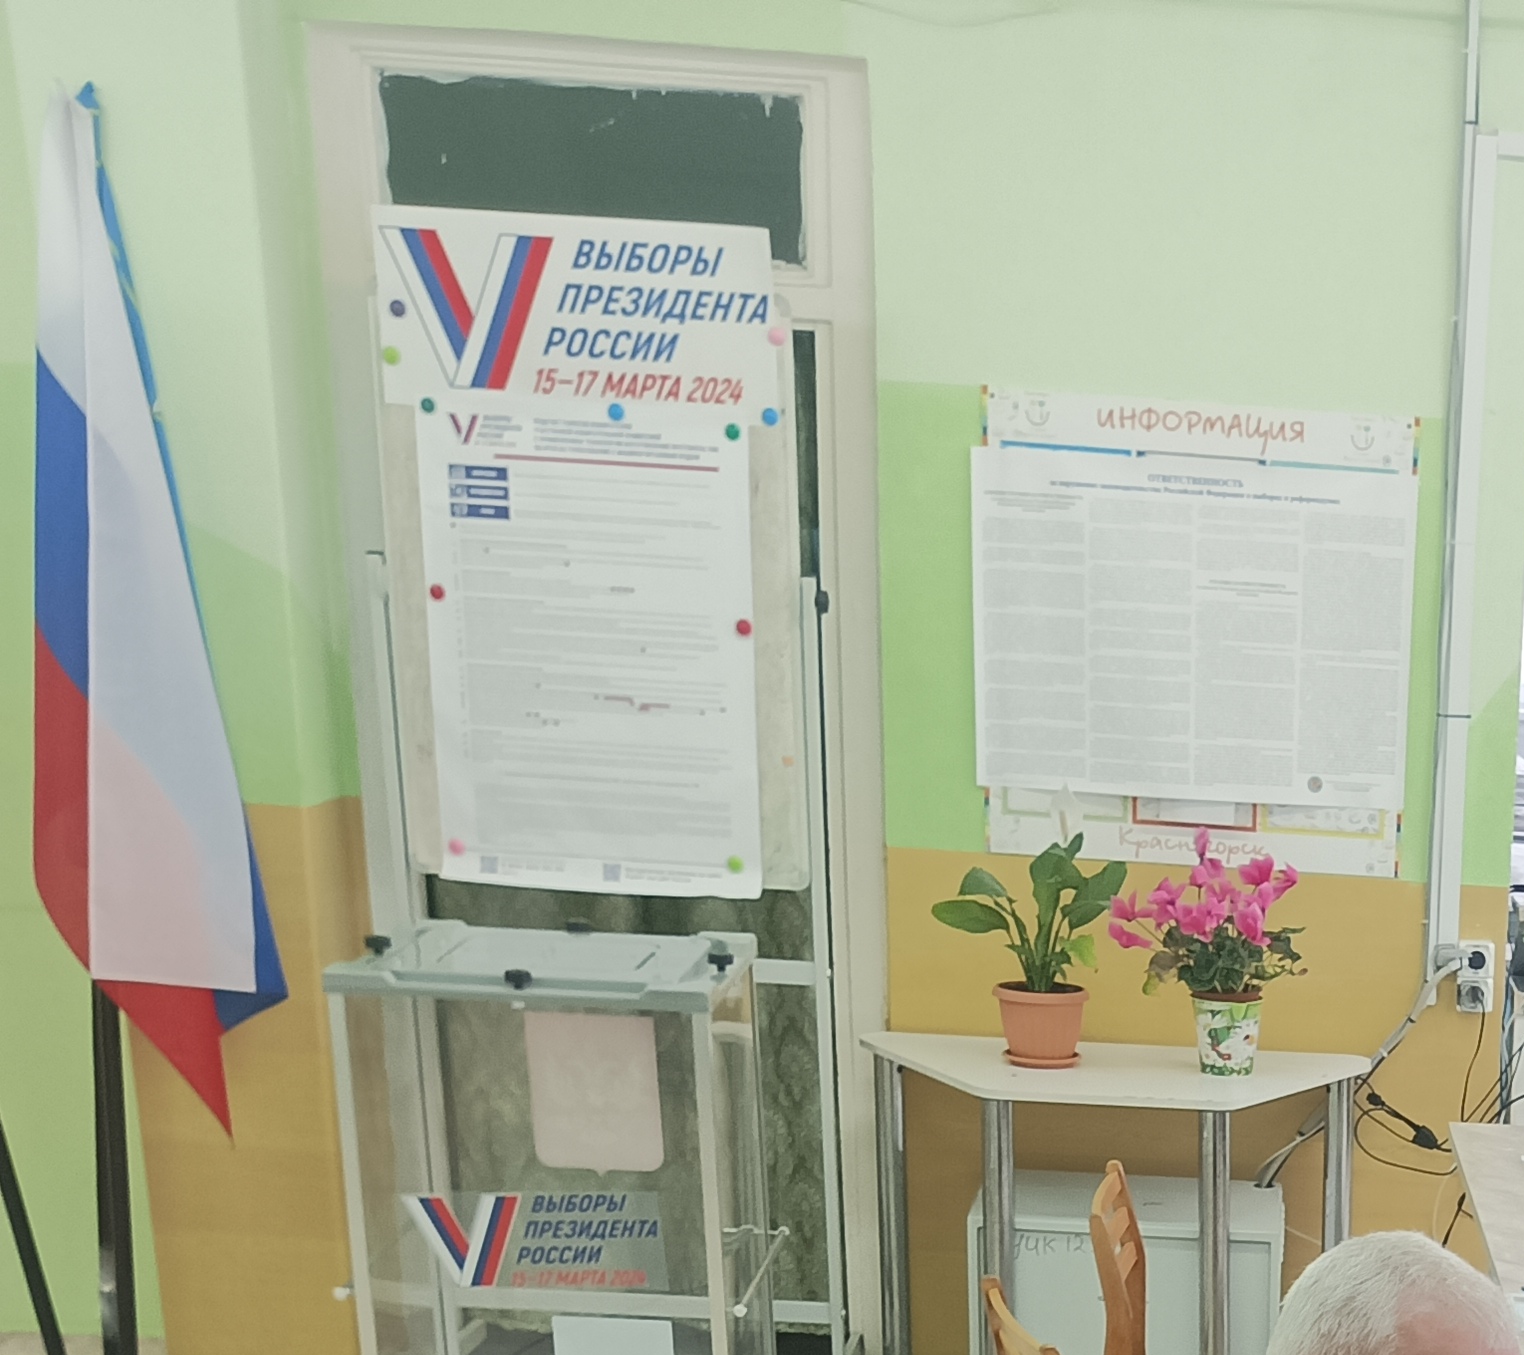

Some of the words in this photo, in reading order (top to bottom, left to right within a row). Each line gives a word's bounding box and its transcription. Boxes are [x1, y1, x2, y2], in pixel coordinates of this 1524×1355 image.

[571, 239, 724, 277] ВЫБОРЫ
[556, 283, 770, 325] ПРЕЗИДЕНТА
[542, 327, 680, 363] РОССИИ
[600, 371, 682, 402] МАРТА
[686, 376, 744, 405] 2024
[1096, 406, 1305, 455] ИНФОРМАЦИЯ
[1118, 825, 1270, 864] Краснгорск
[531, 1194, 628, 1214] ВЫБОРЫ
[523, 1219, 659, 1241] ПРЕЗИДЕНТА
[516, 1245, 603, 1265] РОССИИ
[556, 1269, 607, 1286] МАРТА
